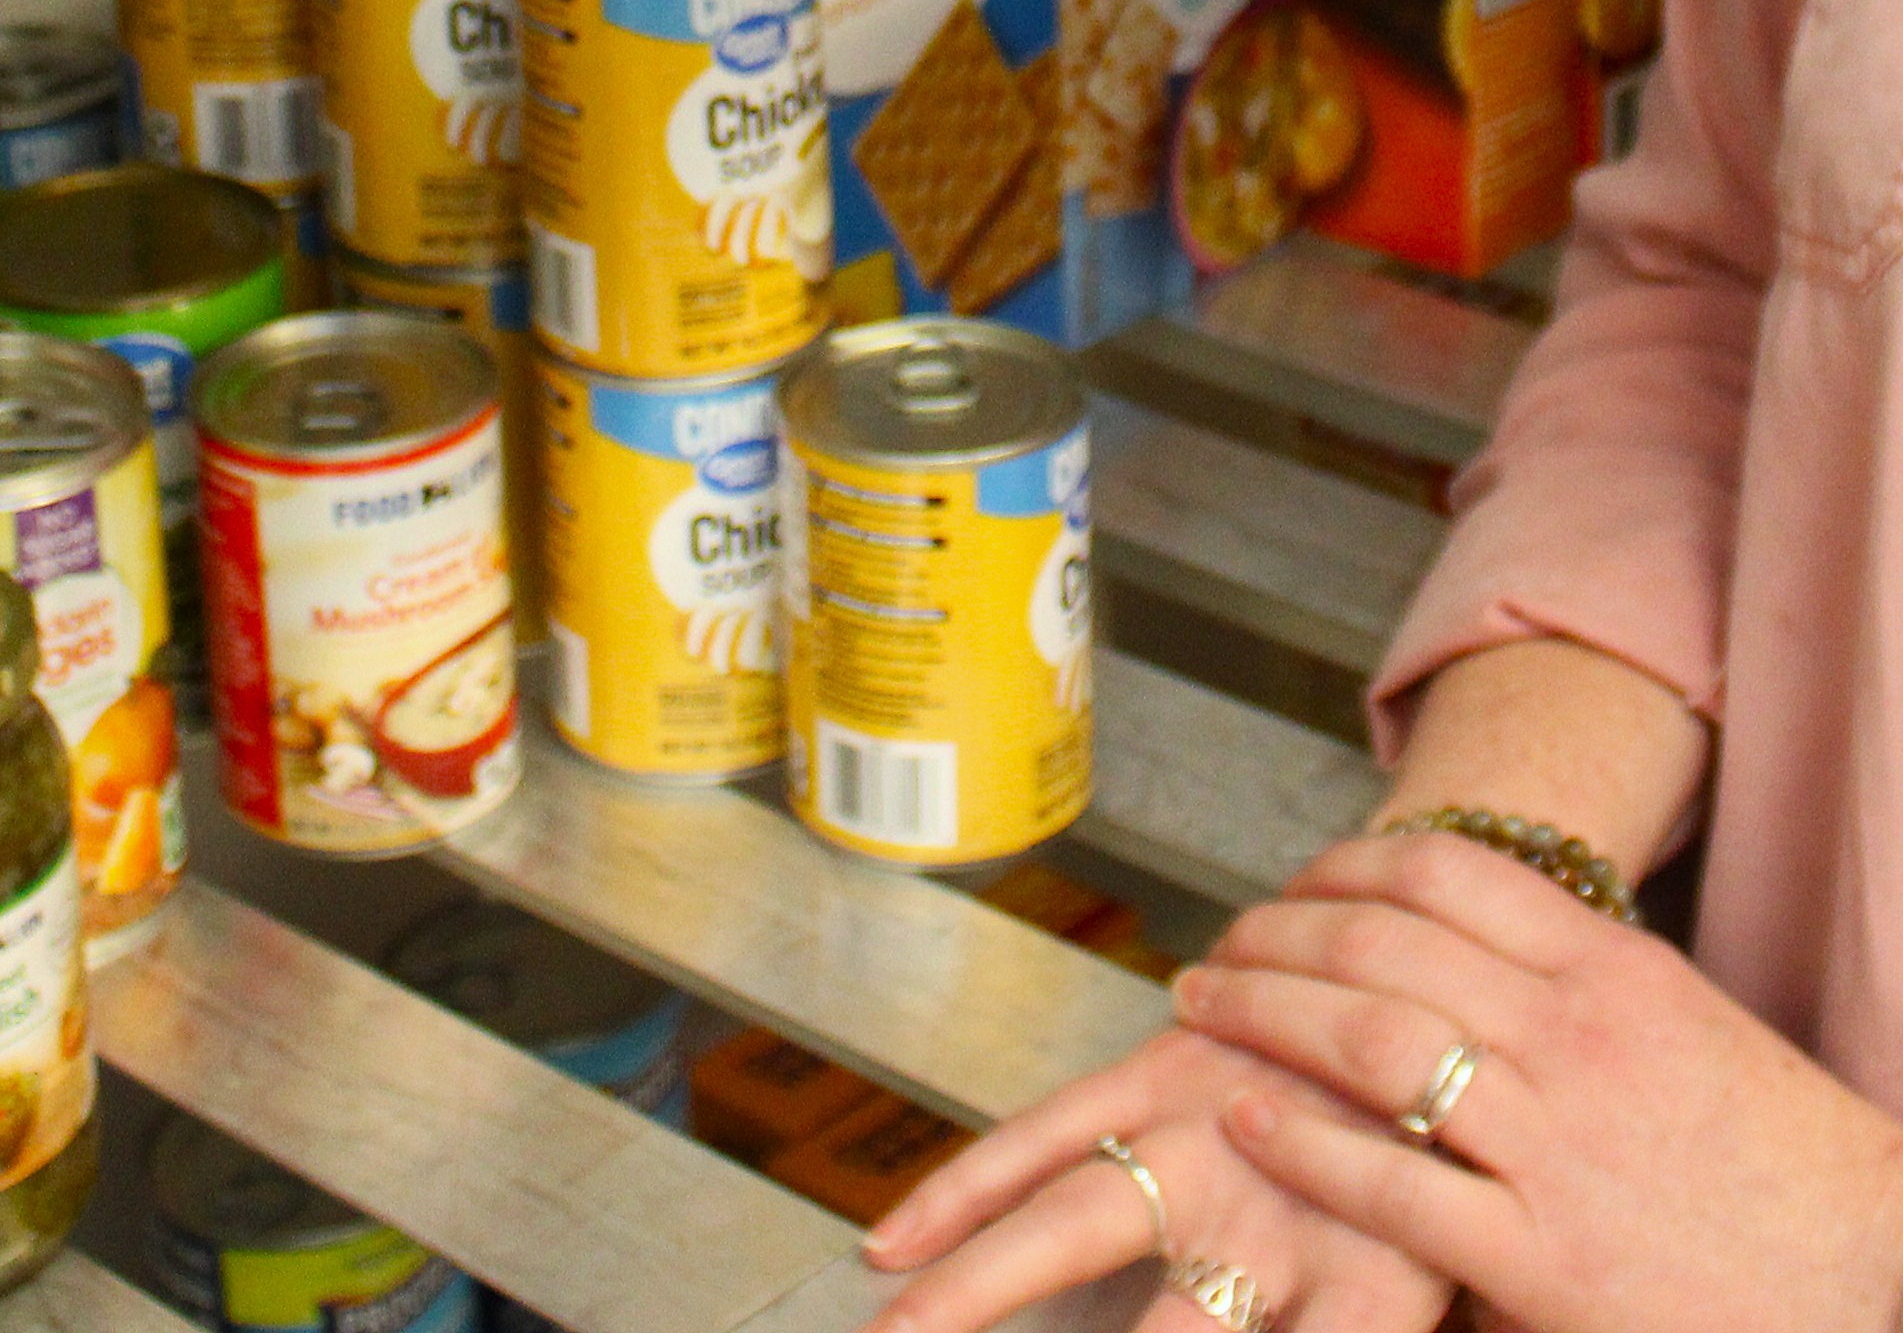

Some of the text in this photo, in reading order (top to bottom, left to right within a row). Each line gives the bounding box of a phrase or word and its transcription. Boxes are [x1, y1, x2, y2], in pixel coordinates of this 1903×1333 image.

[707, 69, 824, 150] Chick
[721, 142, 783, 183] SOUP
[331, 490, 411, 529] FOOD
[690, 505, 782, 565] Chic
